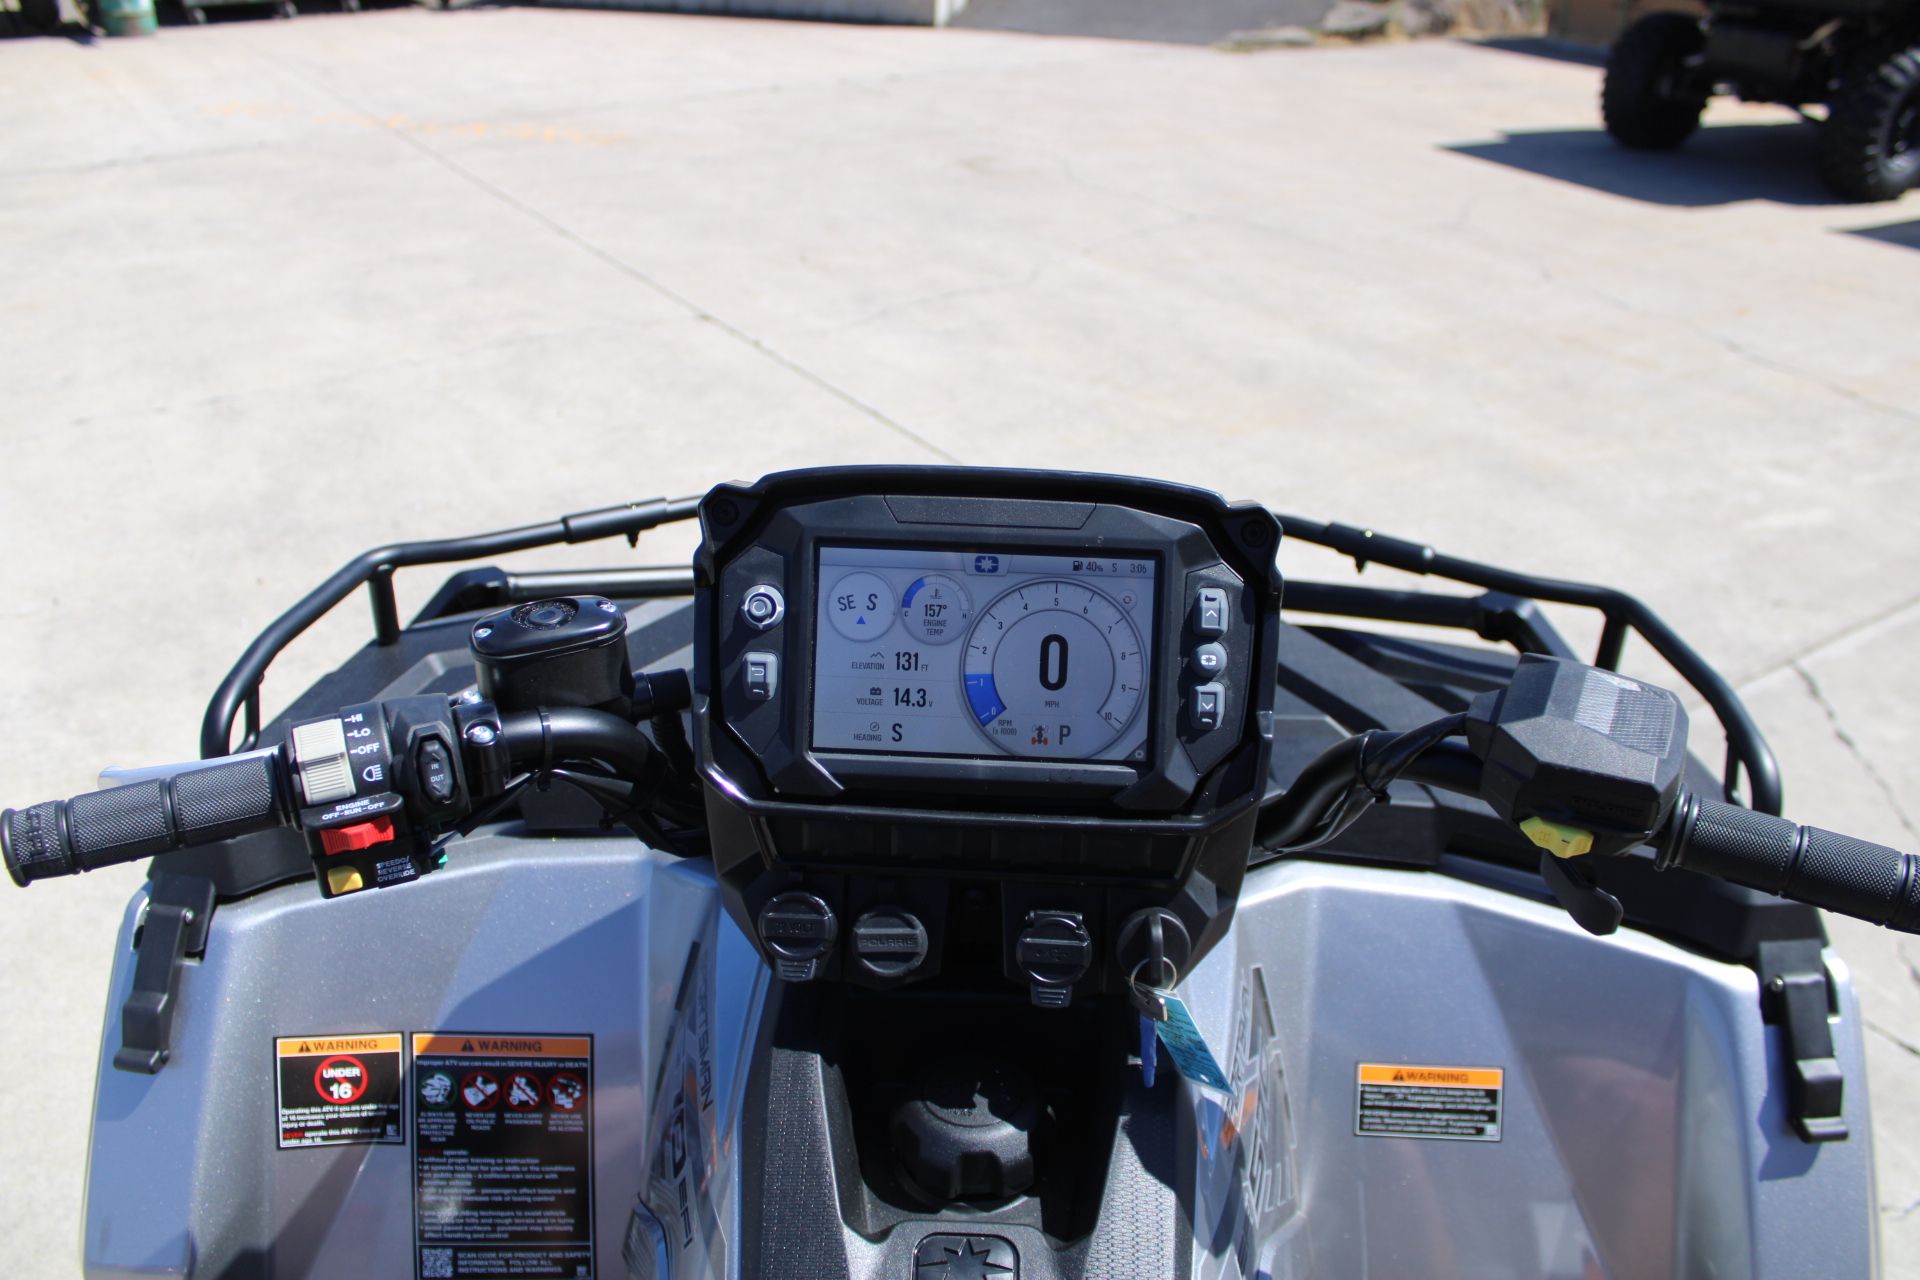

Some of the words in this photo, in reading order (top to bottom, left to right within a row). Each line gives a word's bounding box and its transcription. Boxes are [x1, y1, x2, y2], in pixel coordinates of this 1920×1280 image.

[1111, 563, 1118, 573] S
[1130, 564, 1147, 574] 3:06
[838, 595, 856, 612] SE
[866, 593, 878, 611] S
[1054, 597, 1059, 606] 5
[1023, 603, 1028, 611] 4
[1083, 606, 1088, 615] 6
[923, 619, 947, 628] ENGINE
[998, 621, 1003, 630] 3
[926, 628, 944, 636] TEMP
[1107, 625, 1112, 634] 7
[982, 646, 987, 655] 2
[851, 662, 885, 670] ELEVATION
[895, 651, 919, 672] 131
[921, 664, 928, 672] FT
[1039, 634, 1069, 691] 0
[1121, 684, 1126, 692] 9
[857, 698, 883, 706] VOLTAGE
[894, 688, 927, 708] 14.3
[1044, 700, 1060, 709] MPH
[1104, 712, 1112, 721] 10
[998, 719, 1012, 727] RPM
[853, 734, 882, 742] HEADING
[891, 722, 903, 742] S
[1058, 725, 1072, 746] P
[430, 774, 444, 782] OUT
[335, 799, 370, 812] ENGINE
[313, 1040, 378, 1052] WARNING
[478, 1040, 543, 1052] WARNING
[322, 1066, 361, 1079] UNDER
[1406, 1072, 1470, 1084] WARNING
[330, 1082, 353, 1100] 16
